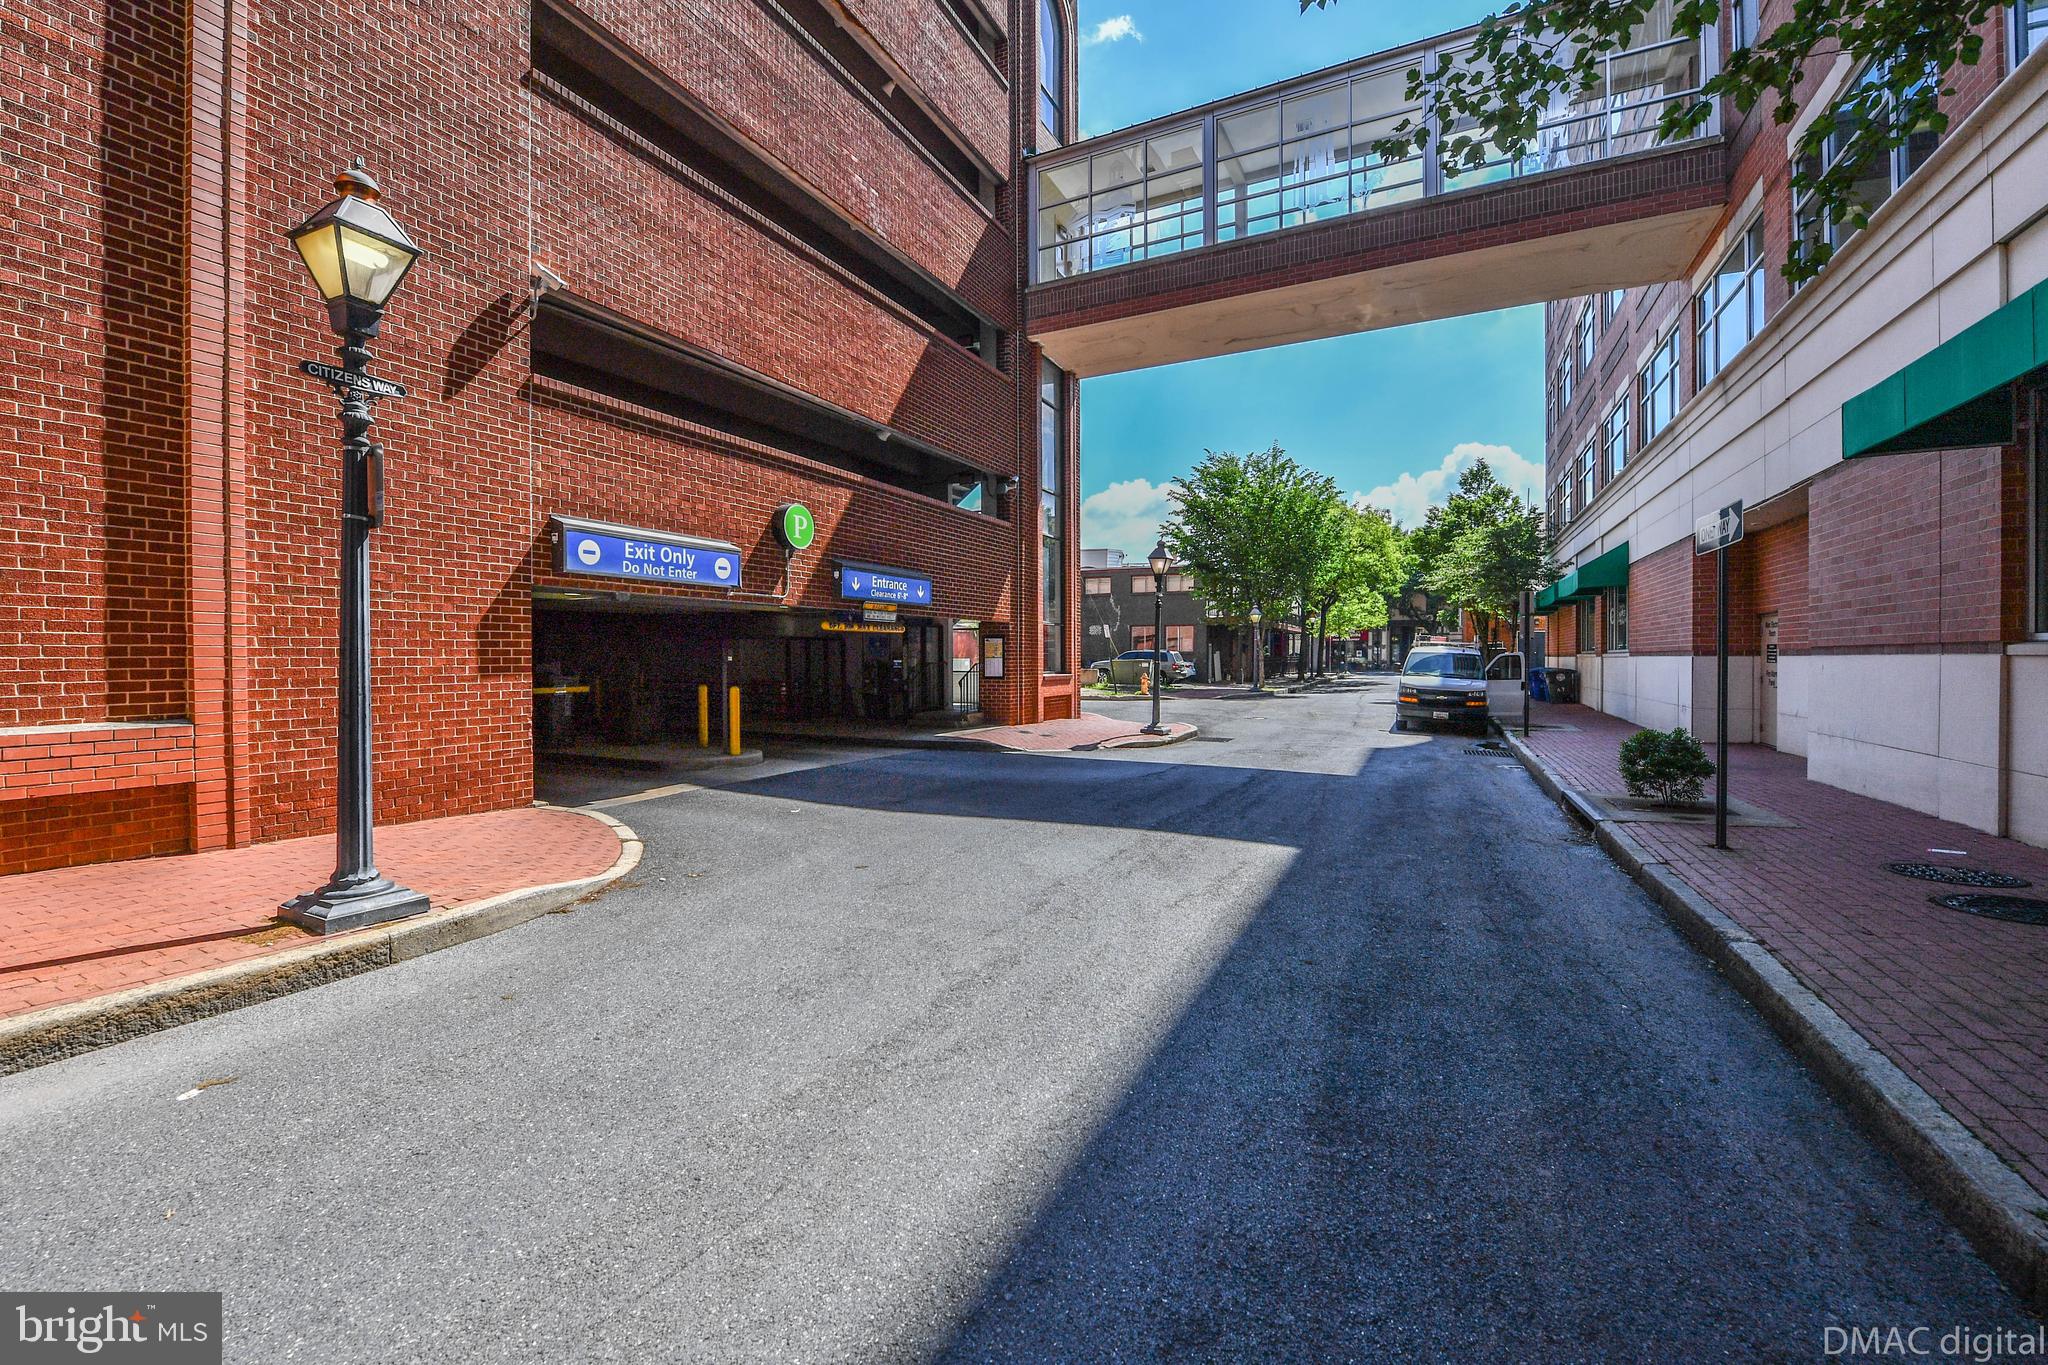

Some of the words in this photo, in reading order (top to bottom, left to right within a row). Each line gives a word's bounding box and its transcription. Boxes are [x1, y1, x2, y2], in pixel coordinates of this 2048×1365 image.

[307, 363, 371, 388] CITIZENS
[373, 380, 397, 395] WAY
[793, 514, 808, 539] P
[625, 542, 655, 562] Exit
[660, 547, 695, 569] Only
[622, 561, 640, 574] Do
[643, 563, 665, 577] Not
[668, 566, 698, 580] Enter
[871, 589, 896, 599] Clearance
[872, 576, 908, 591] Entrance
